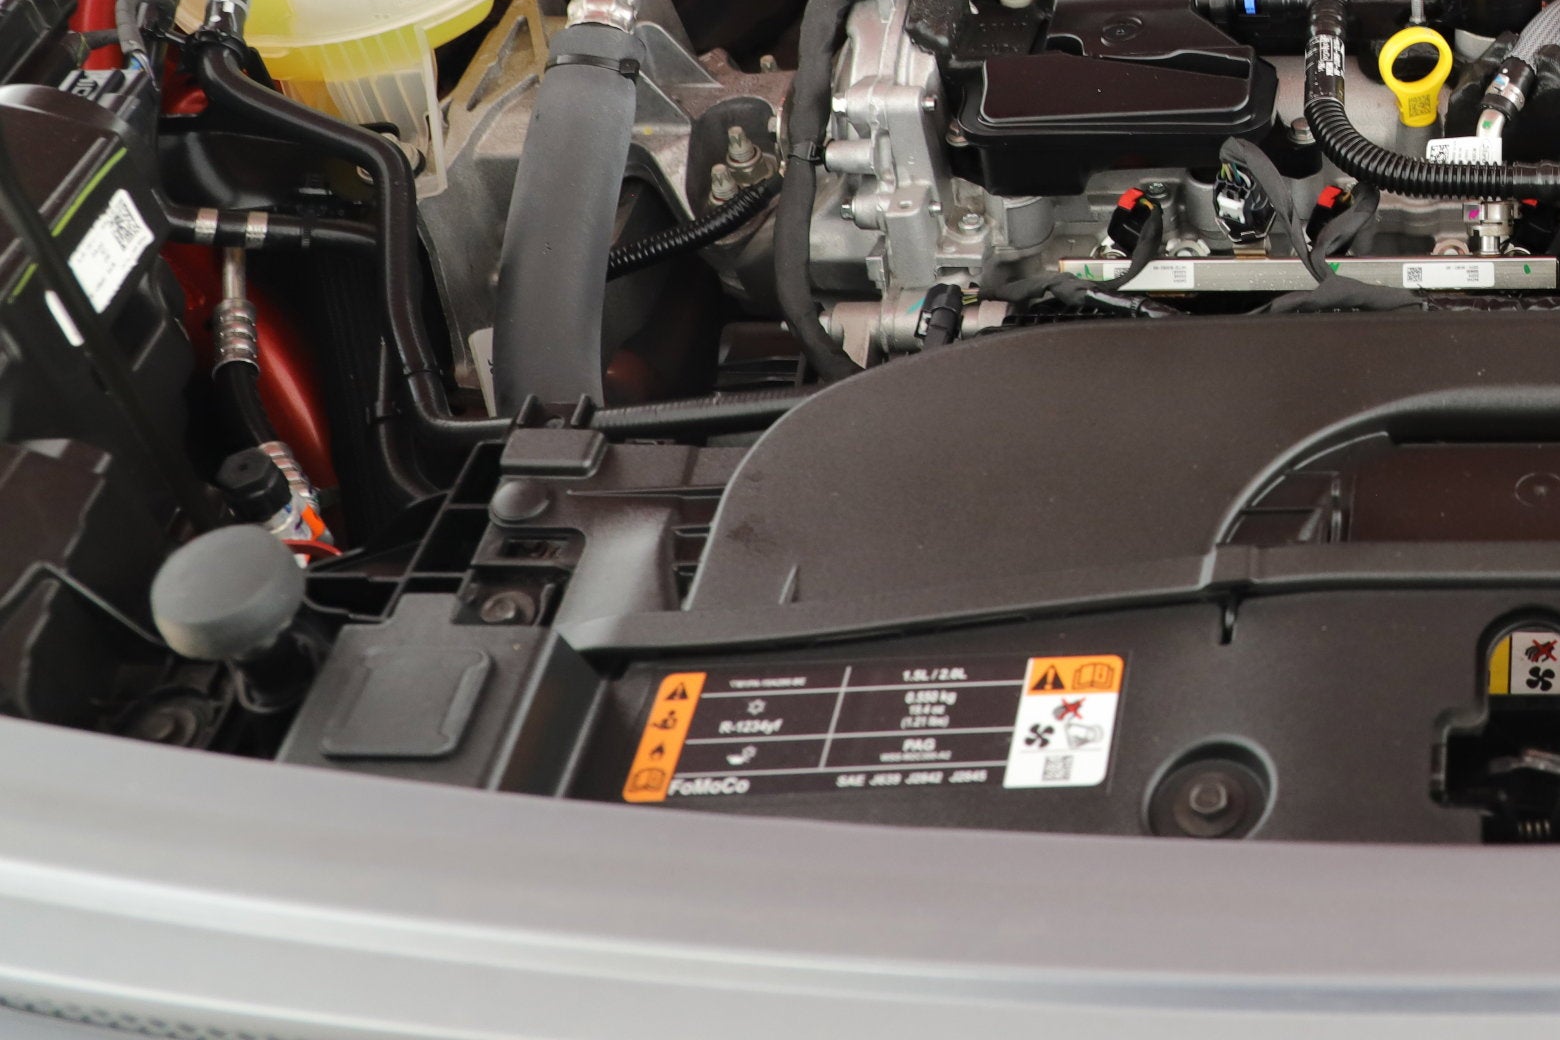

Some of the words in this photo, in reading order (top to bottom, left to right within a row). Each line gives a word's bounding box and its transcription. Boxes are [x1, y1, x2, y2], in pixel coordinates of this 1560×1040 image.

[939, 689, 958, 706] kg
[718, 718, 783, 735] R-1234yf
[902, 737, 936, 752] PAG
[667, 776, 751, 796] FoMoCo
[836, 774, 866, 788] SAE
